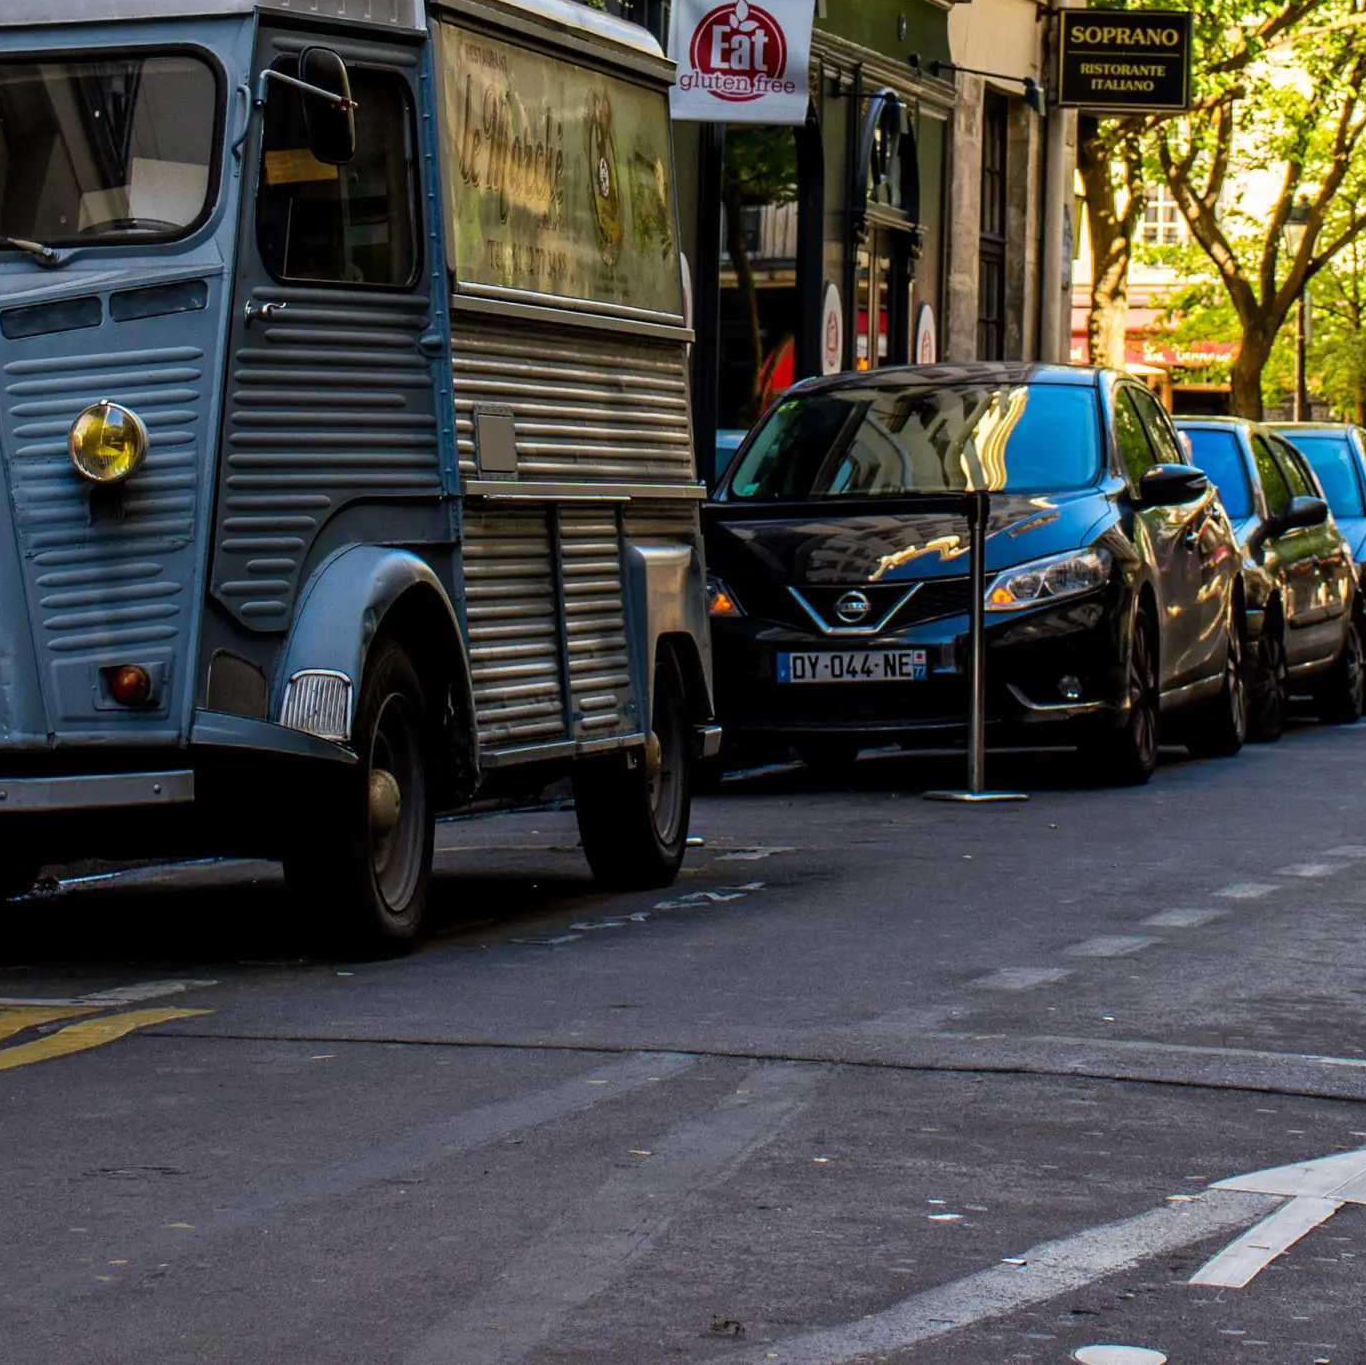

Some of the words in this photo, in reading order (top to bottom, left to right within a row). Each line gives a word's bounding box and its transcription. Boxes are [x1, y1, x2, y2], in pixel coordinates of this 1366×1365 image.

[1070, 26, 1179, 46] SOPRANO
[710, 25, 769, 71] Eat
[1080, 62, 1166, 77] RISTORANTE
[679, 67, 749, 91] gluten
[756, 73, 795, 94] free
[1091, 79, 1154, 92] ITALIANO
